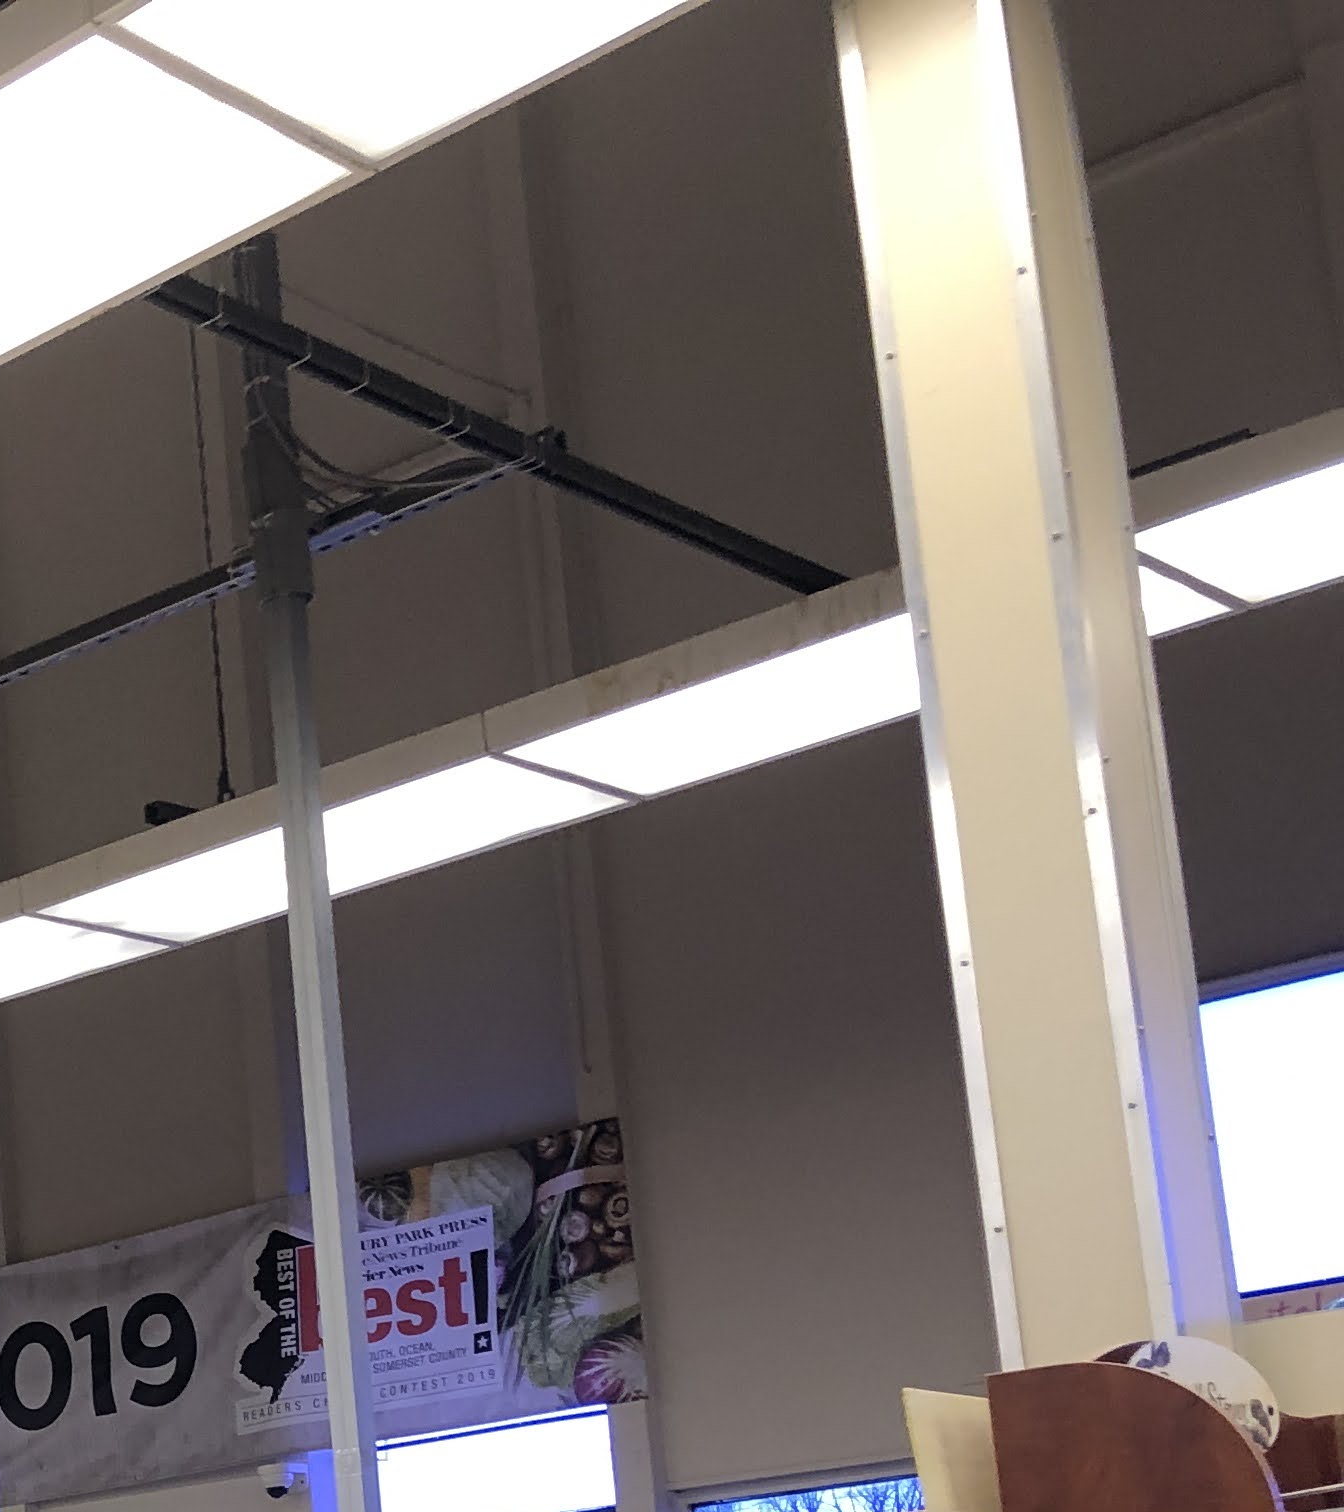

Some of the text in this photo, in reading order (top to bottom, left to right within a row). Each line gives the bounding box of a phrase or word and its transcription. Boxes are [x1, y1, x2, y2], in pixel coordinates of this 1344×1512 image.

[395, 1228, 434, 1245] PARK
[438, 1215, 488, 1237] PRESS
[276, 1248, 297, 1358] BEST OF THE
[379, 1369, 496, 1399] CONTEST 2019
[243, 1400, 302, 1421] READERS
